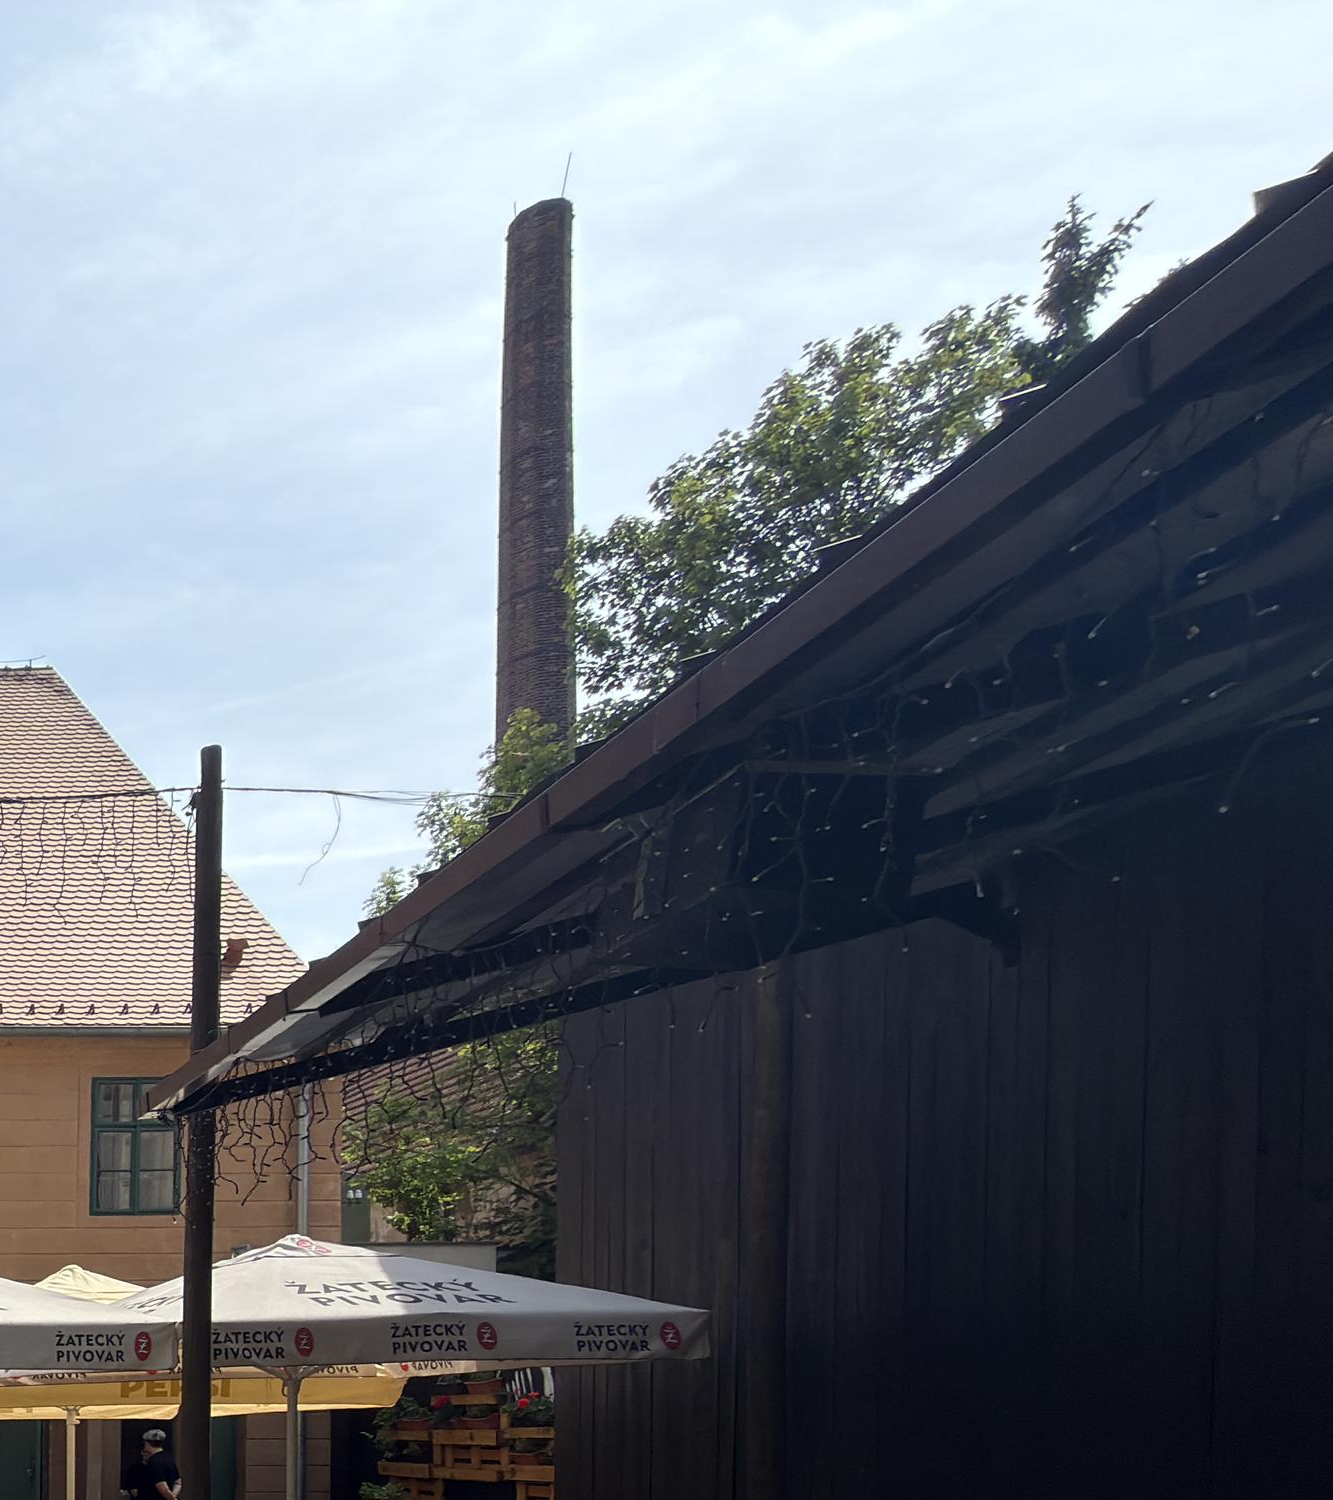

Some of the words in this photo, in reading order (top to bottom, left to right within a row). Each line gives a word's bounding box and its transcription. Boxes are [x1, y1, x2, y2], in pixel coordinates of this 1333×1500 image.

[285, 1279, 479, 1294] ŽATECKÝ
[309, 1293, 517, 1306] PIVOVAR
[213, 1328, 284, 1344] ŽATECKÝ
[391, 1322, 466, 1338] ŽATECKÝ
[56, 1331, 125, 1347] ŽATECKÝ
[577, 1340, 651, 1352] PIVOVAR
[214, 1347, 285, 1360] PIVOVAR
[393, 1340, 468, 1354] PIVOVAR
[56, 1350, 125, 1362] PIVOVAR
